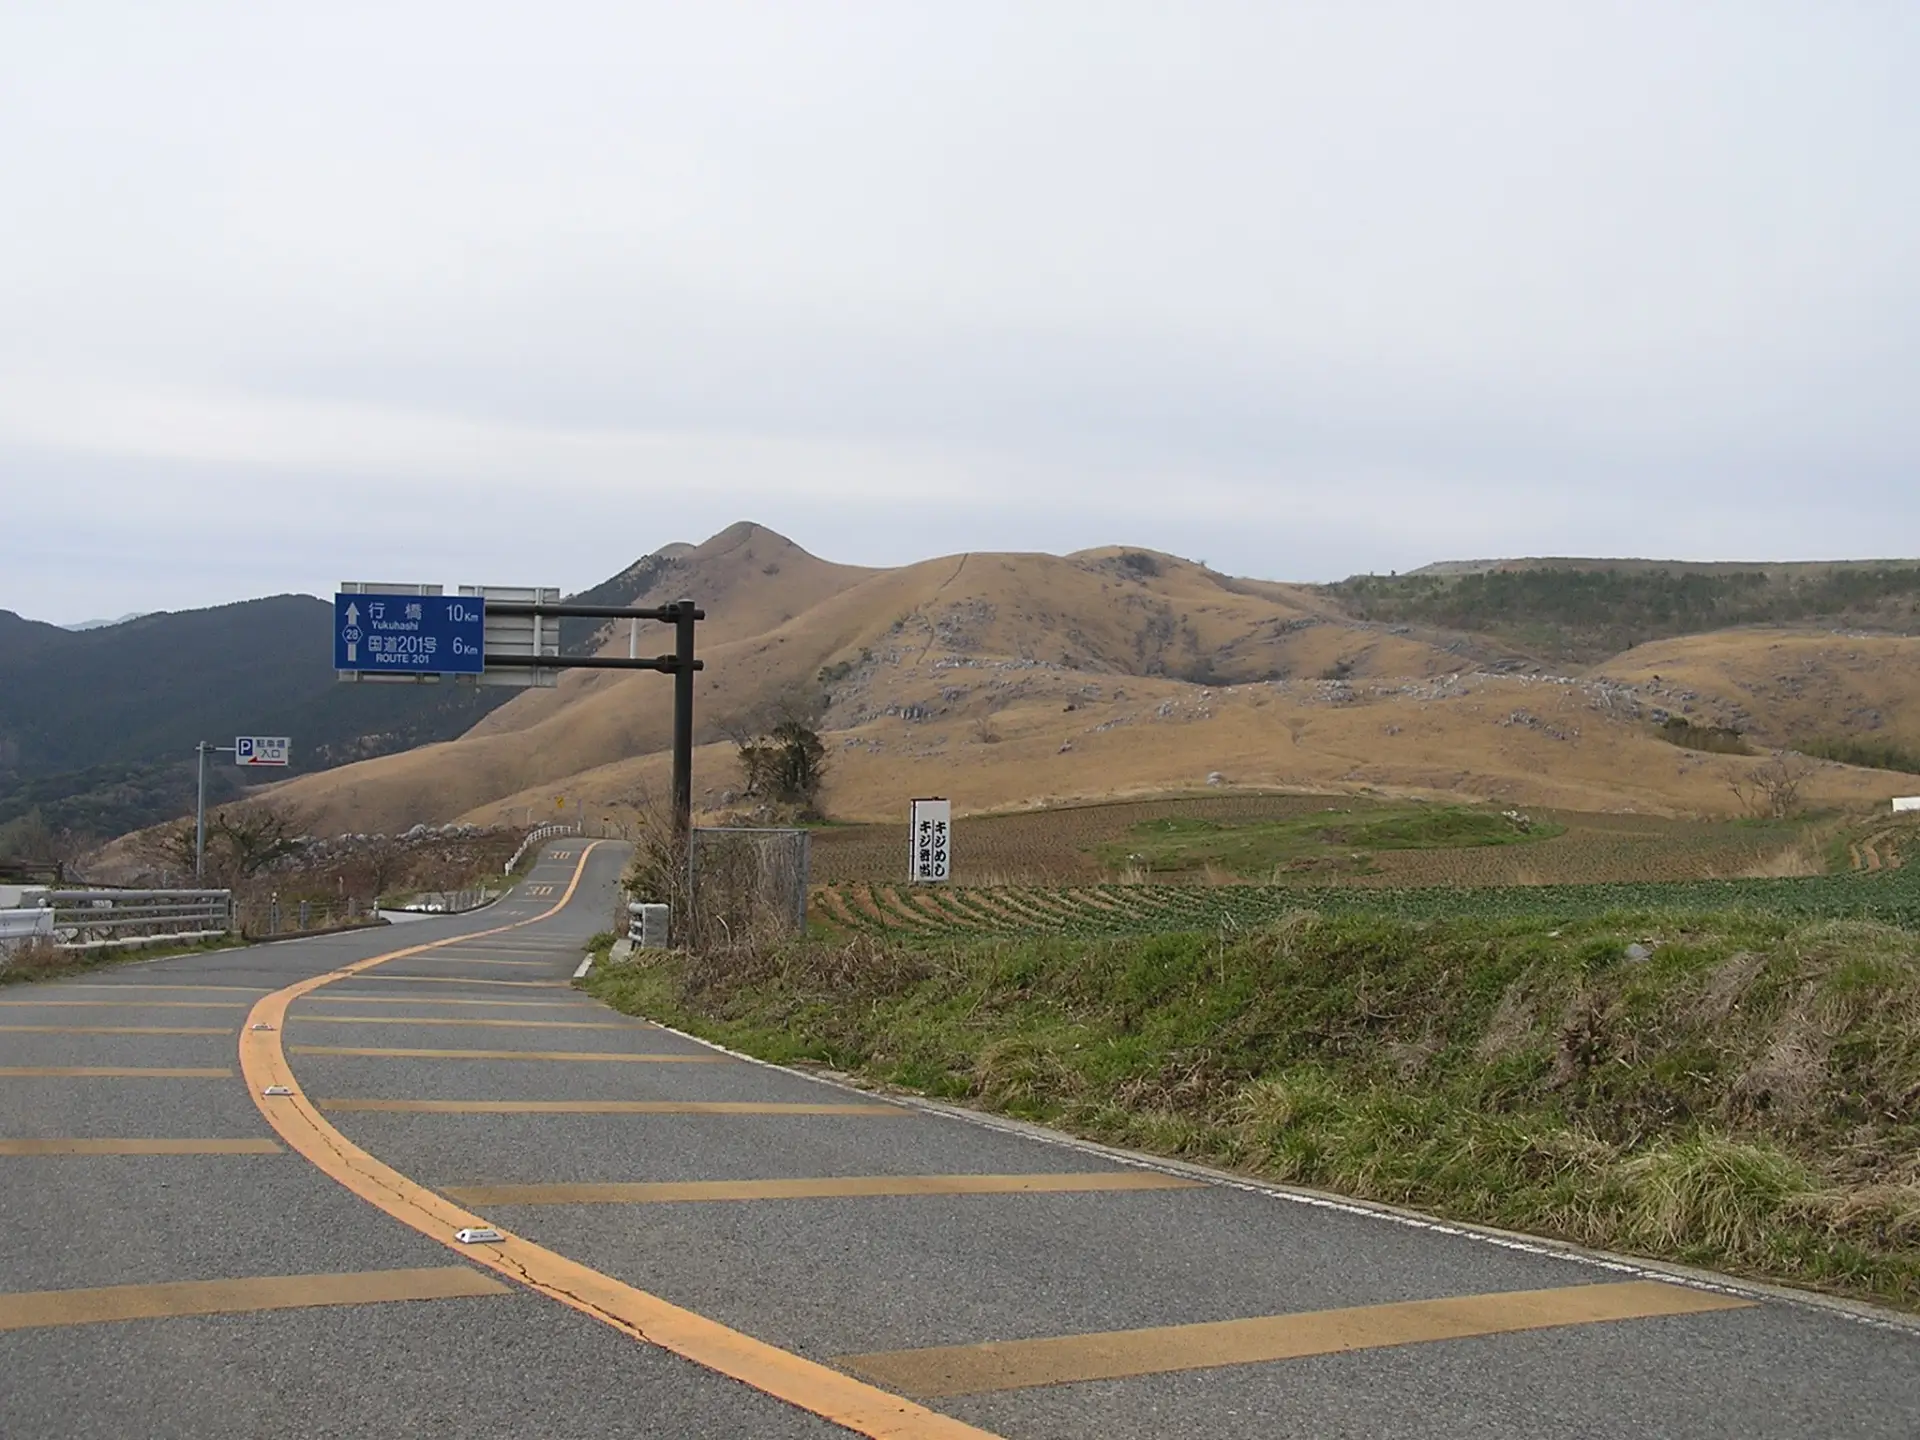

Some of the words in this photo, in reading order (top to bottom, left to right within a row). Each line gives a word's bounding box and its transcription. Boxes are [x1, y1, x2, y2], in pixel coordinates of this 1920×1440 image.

[372, 620, 418, 630] Yukuhashi
[346, 629, 359, 640] 28
[368, 636, 437, 653] 国道201号
[375, 653, 409, 663] ROUTE
[412, 654, 430, 664] 201
[240, 740, 251, 754] P
[935, 821, 946, 877] キジめし
[547, 850, 572, 860] 30
[525, 885, 554, 896] 30
